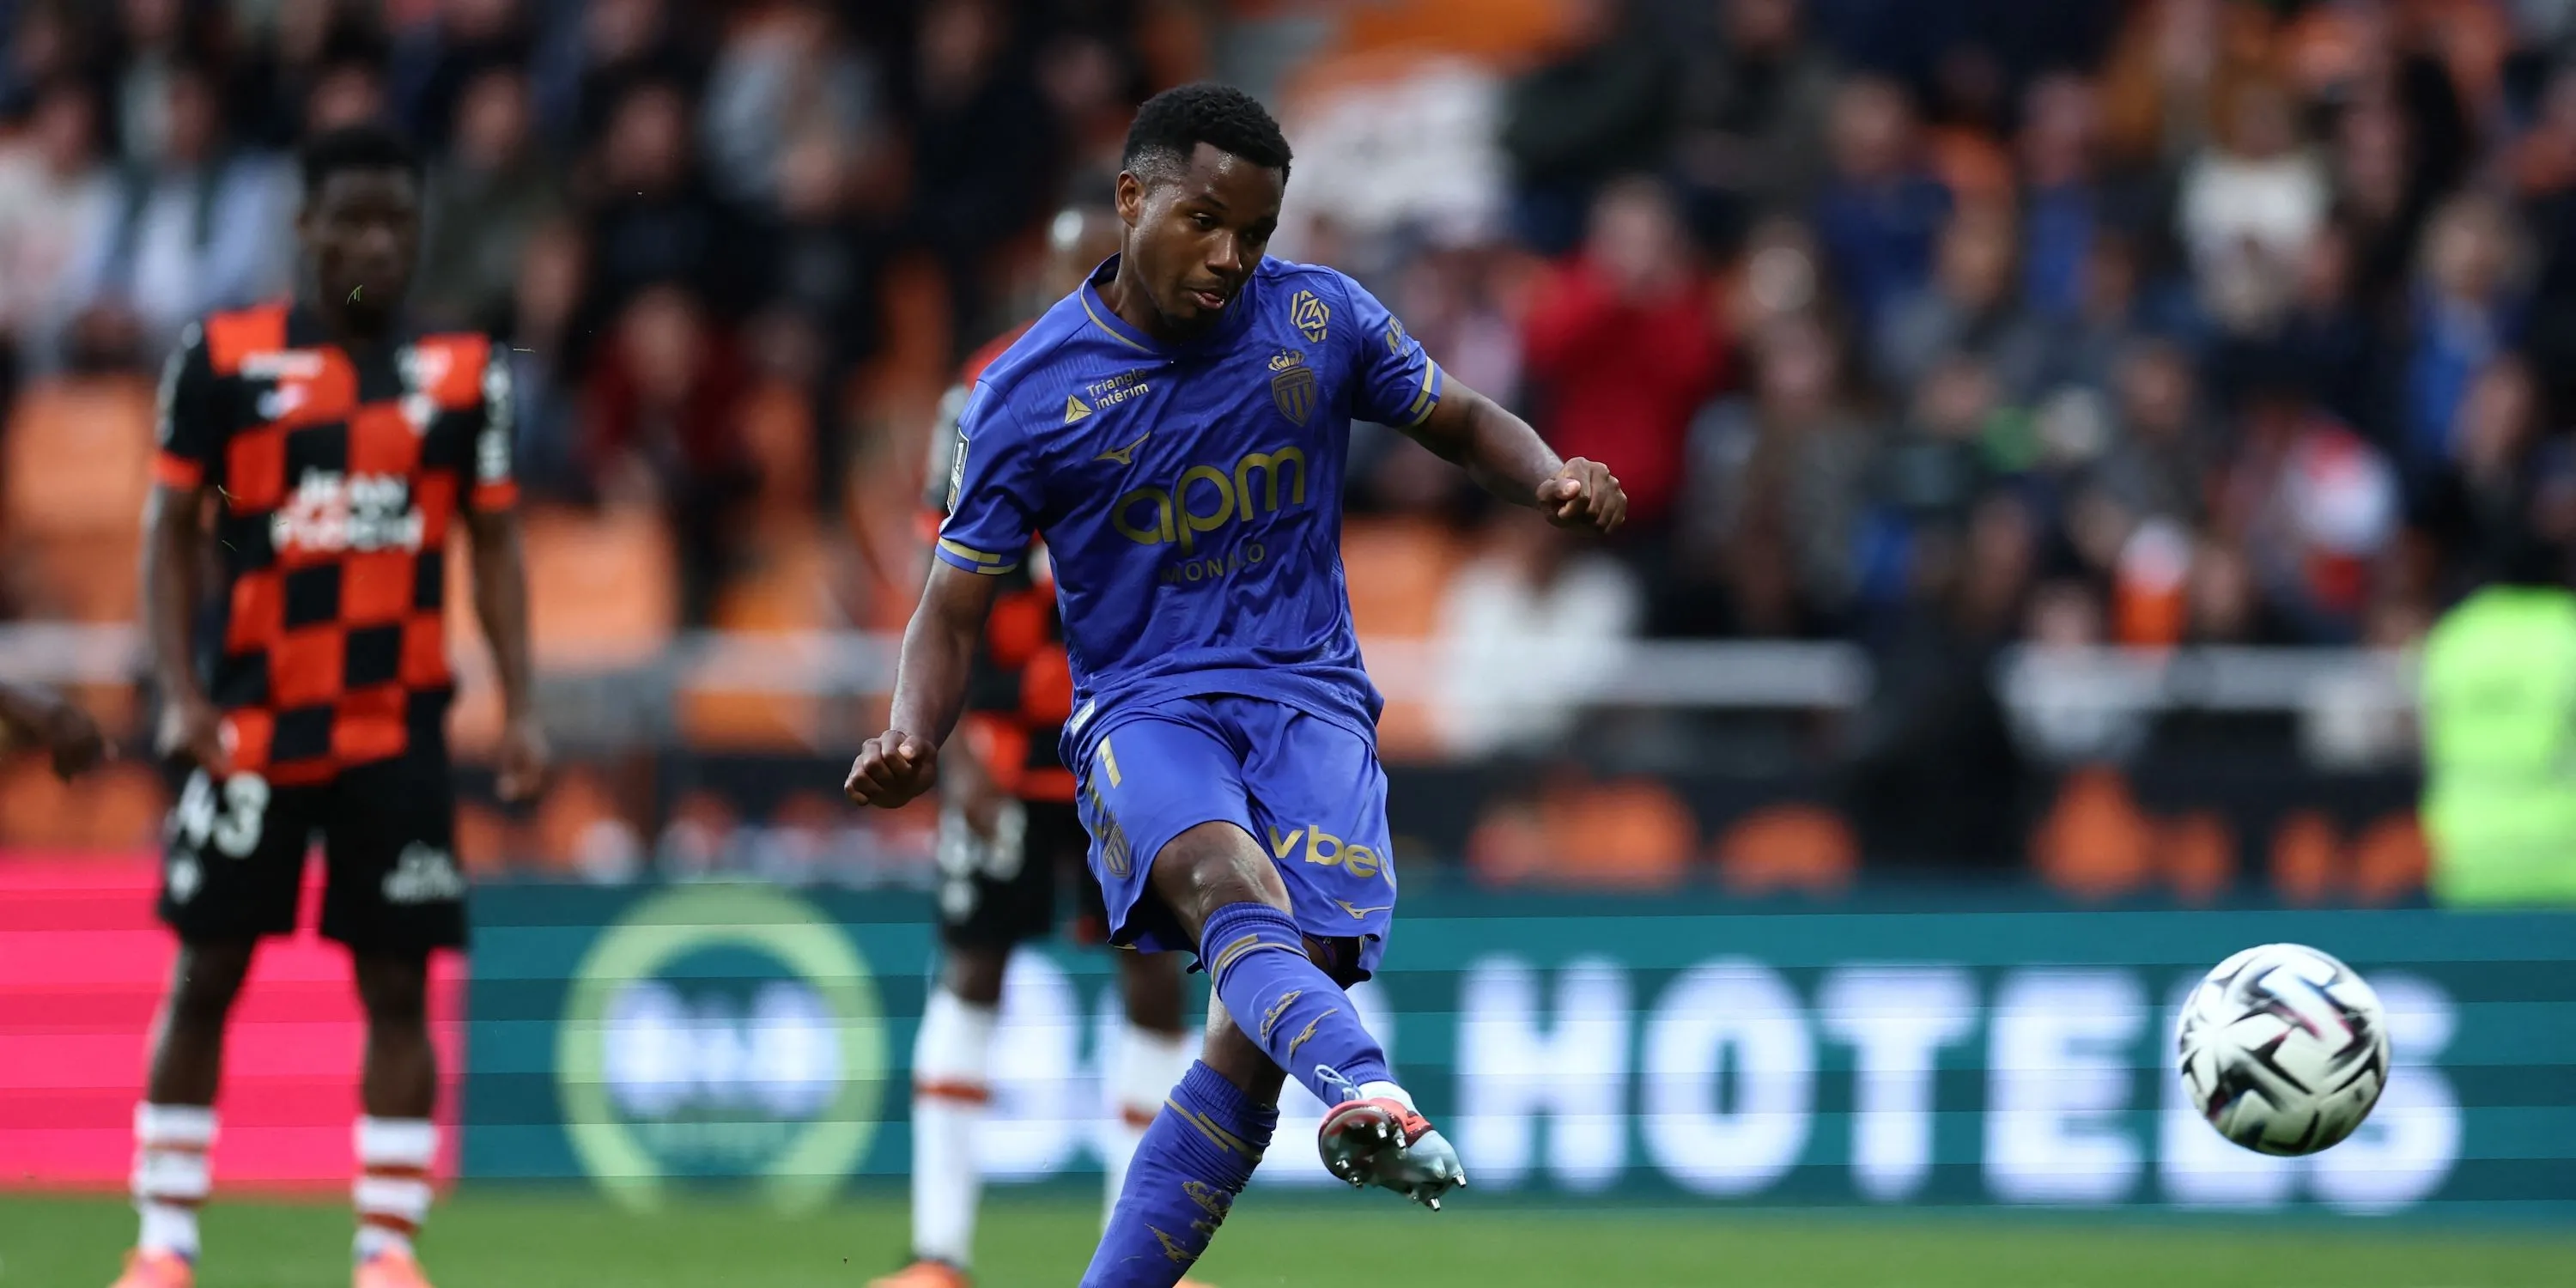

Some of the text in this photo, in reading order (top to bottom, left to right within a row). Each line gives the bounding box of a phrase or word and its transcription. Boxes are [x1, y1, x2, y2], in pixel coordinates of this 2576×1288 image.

[1085, 368, 1146, 397] Triangle
[1094, 383, 1149, 410] intérim
[1113, 447, 1304, 556] apm
[1161, 544, 1265, 584] MONAO
